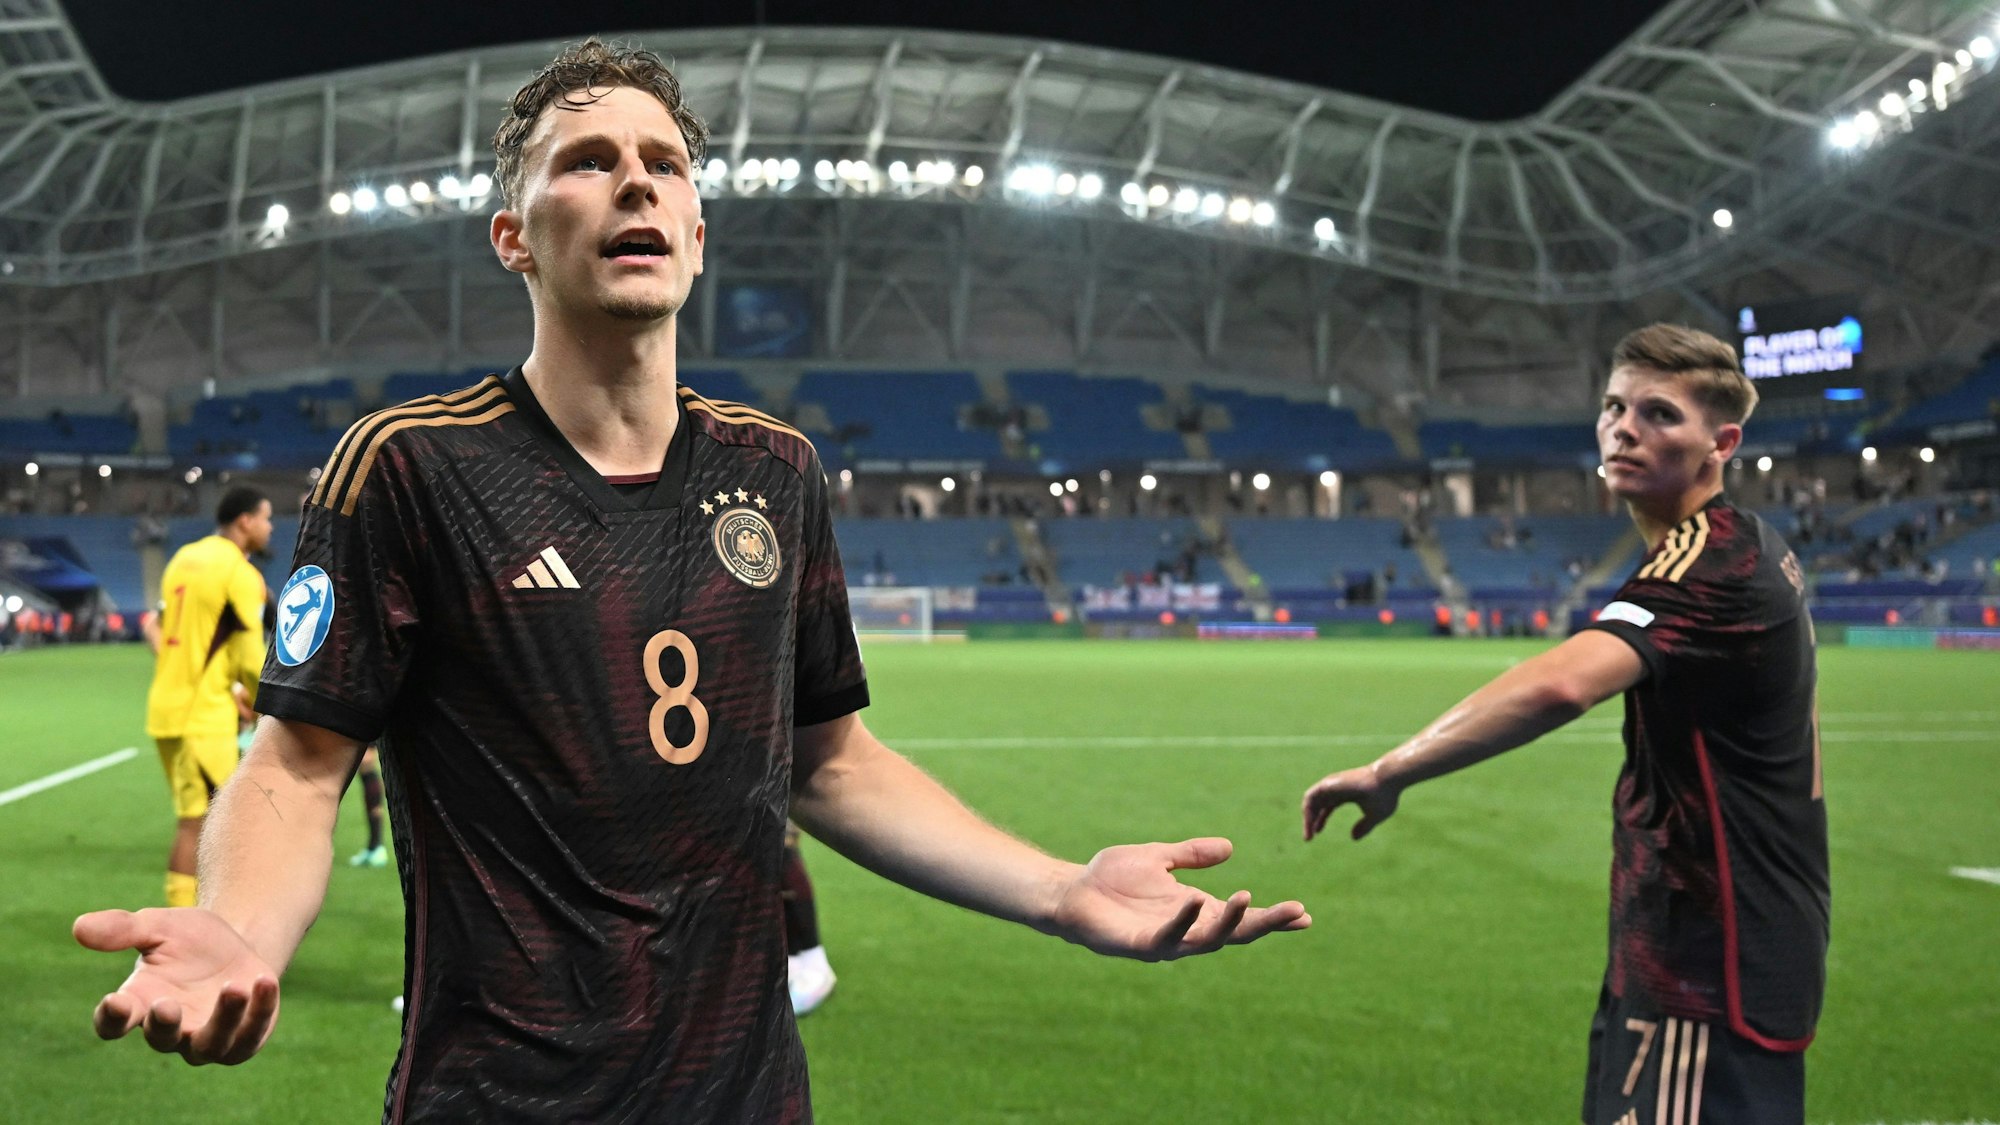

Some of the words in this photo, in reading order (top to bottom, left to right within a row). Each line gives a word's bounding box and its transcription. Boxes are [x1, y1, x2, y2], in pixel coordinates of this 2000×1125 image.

[726, 518, 763, 535] DEUTSCHER
[643, 629, 709, 765] 8
[1622, 1017, 1658, 1097] 7
